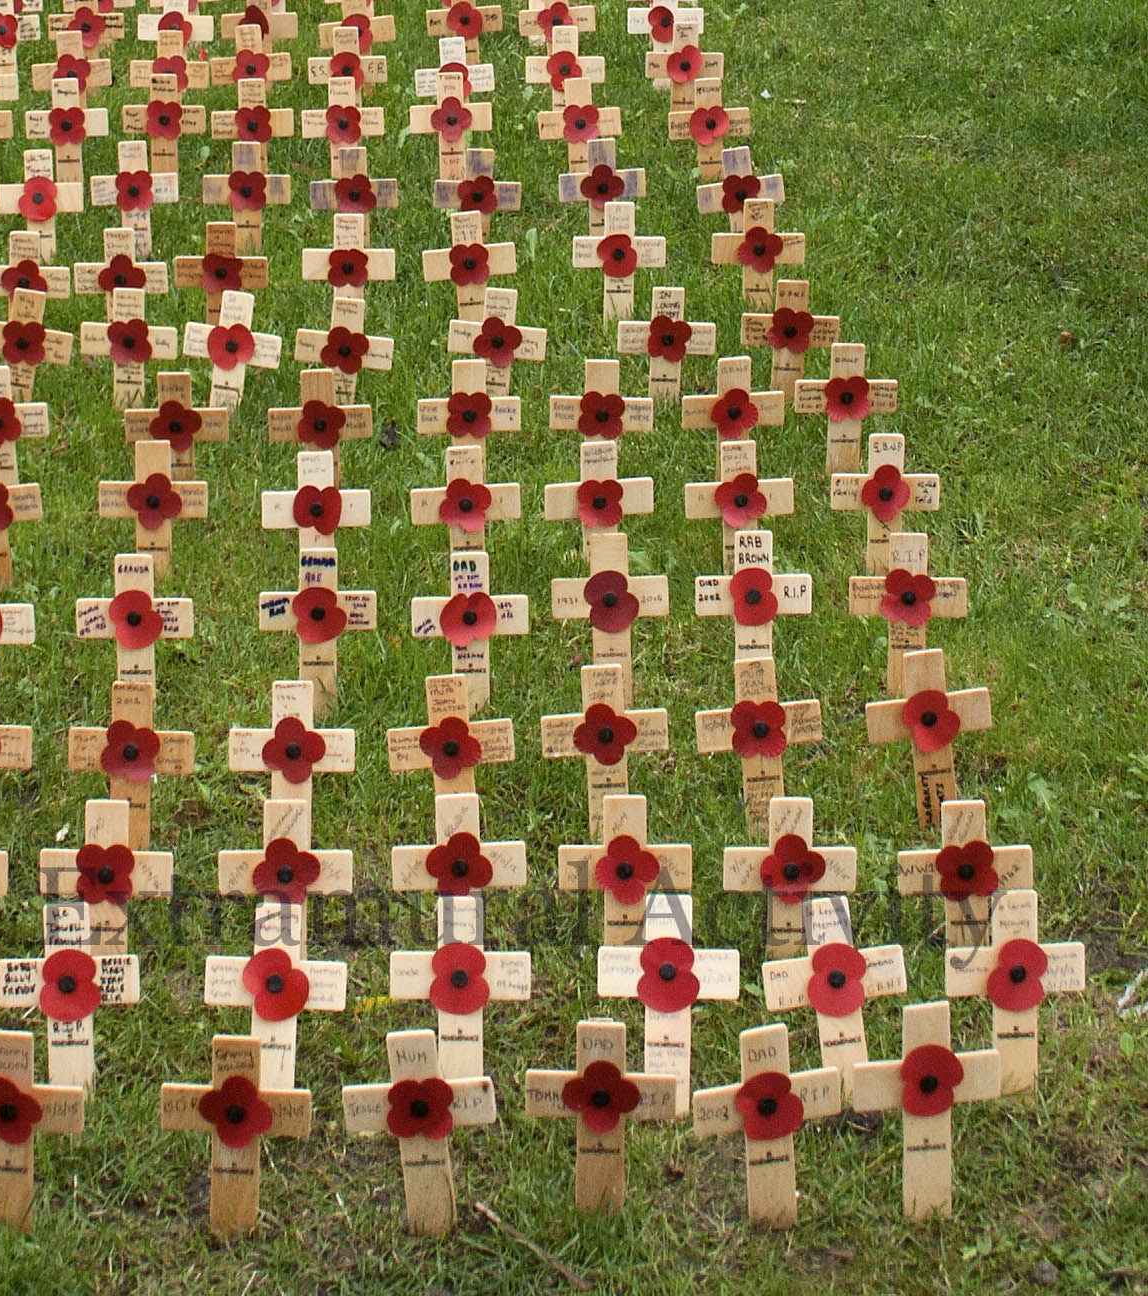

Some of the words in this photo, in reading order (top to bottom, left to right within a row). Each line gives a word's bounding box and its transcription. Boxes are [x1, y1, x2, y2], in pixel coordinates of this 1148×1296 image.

[739, 535, 762, 549] RAB
[738, 552, 770, 565] BROWN
[582, 1038, 614, 1051] DAD
[395, 1049, 428, 1065] MUM
[747, 1046, 777, 1064] DAD
